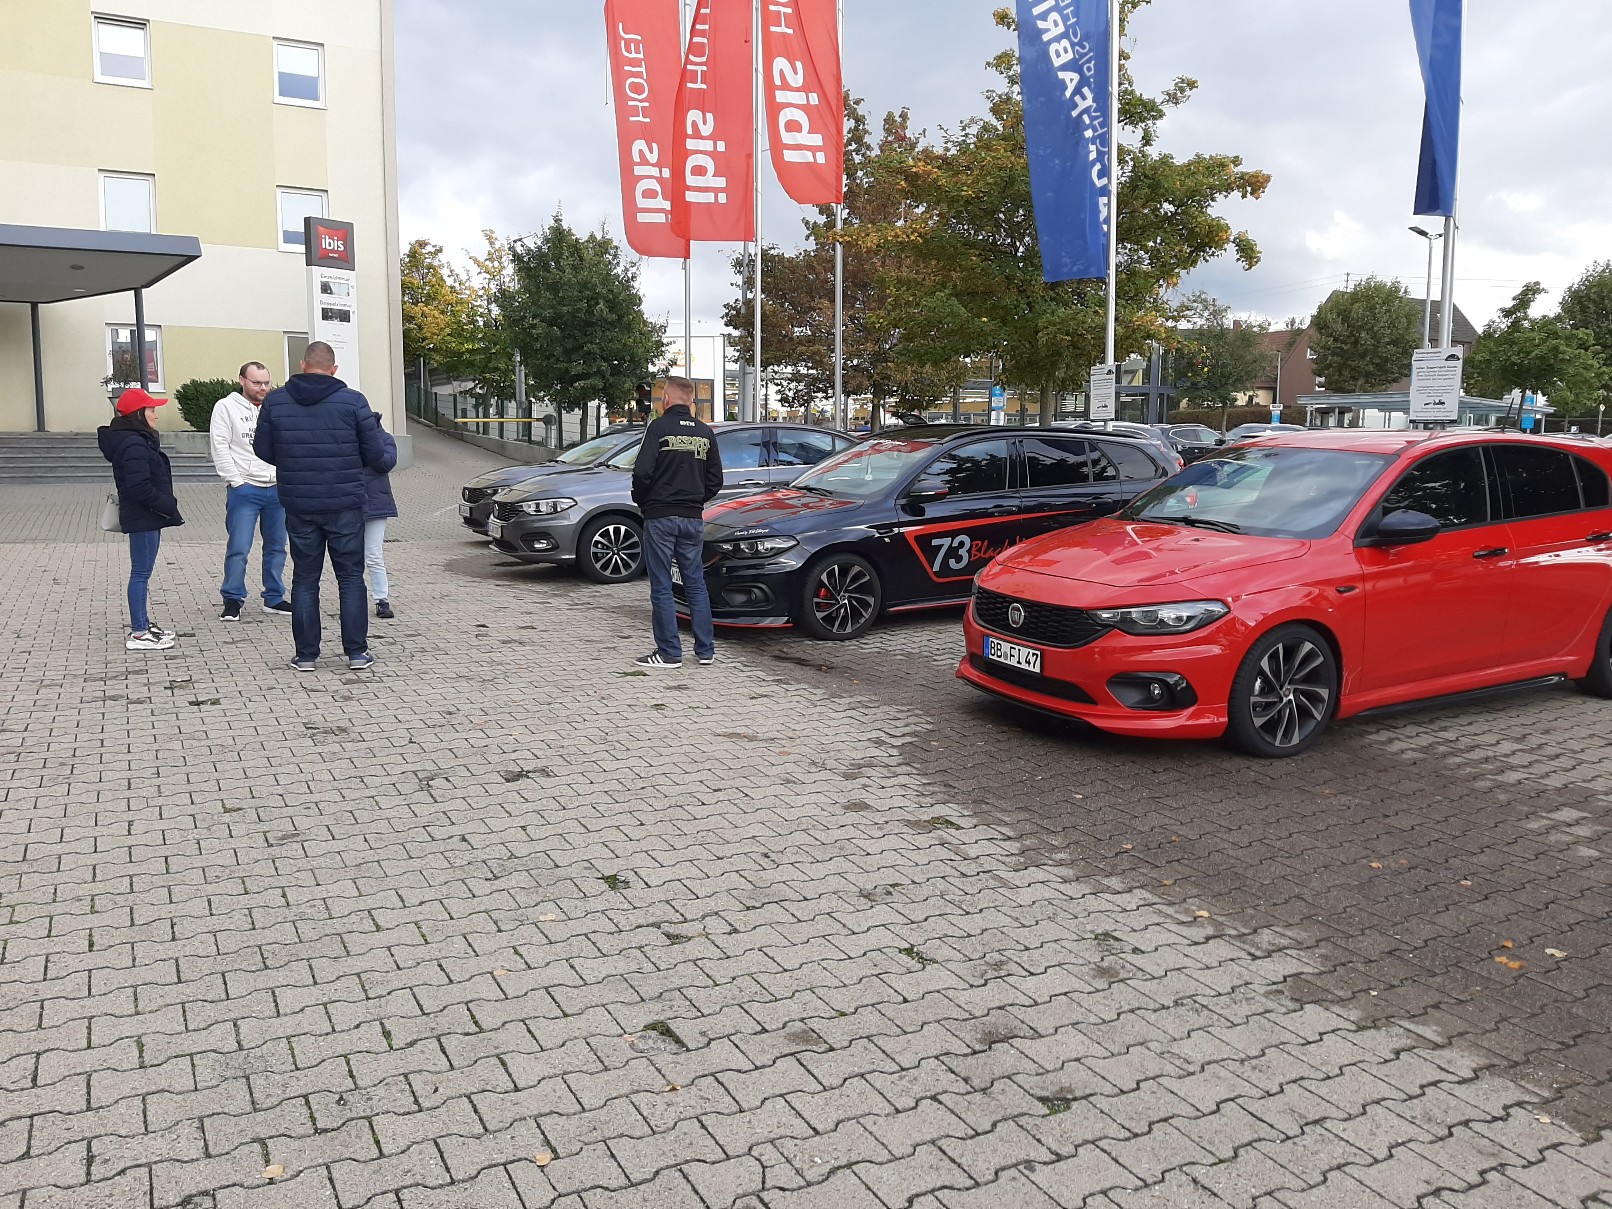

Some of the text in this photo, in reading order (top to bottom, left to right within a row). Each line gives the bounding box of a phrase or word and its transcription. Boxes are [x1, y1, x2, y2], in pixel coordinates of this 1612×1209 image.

[321, 234, 345, 252] ibis
[931, 534, 971, 572] 73
[990, 640, 1039, 669] BB FI 47
